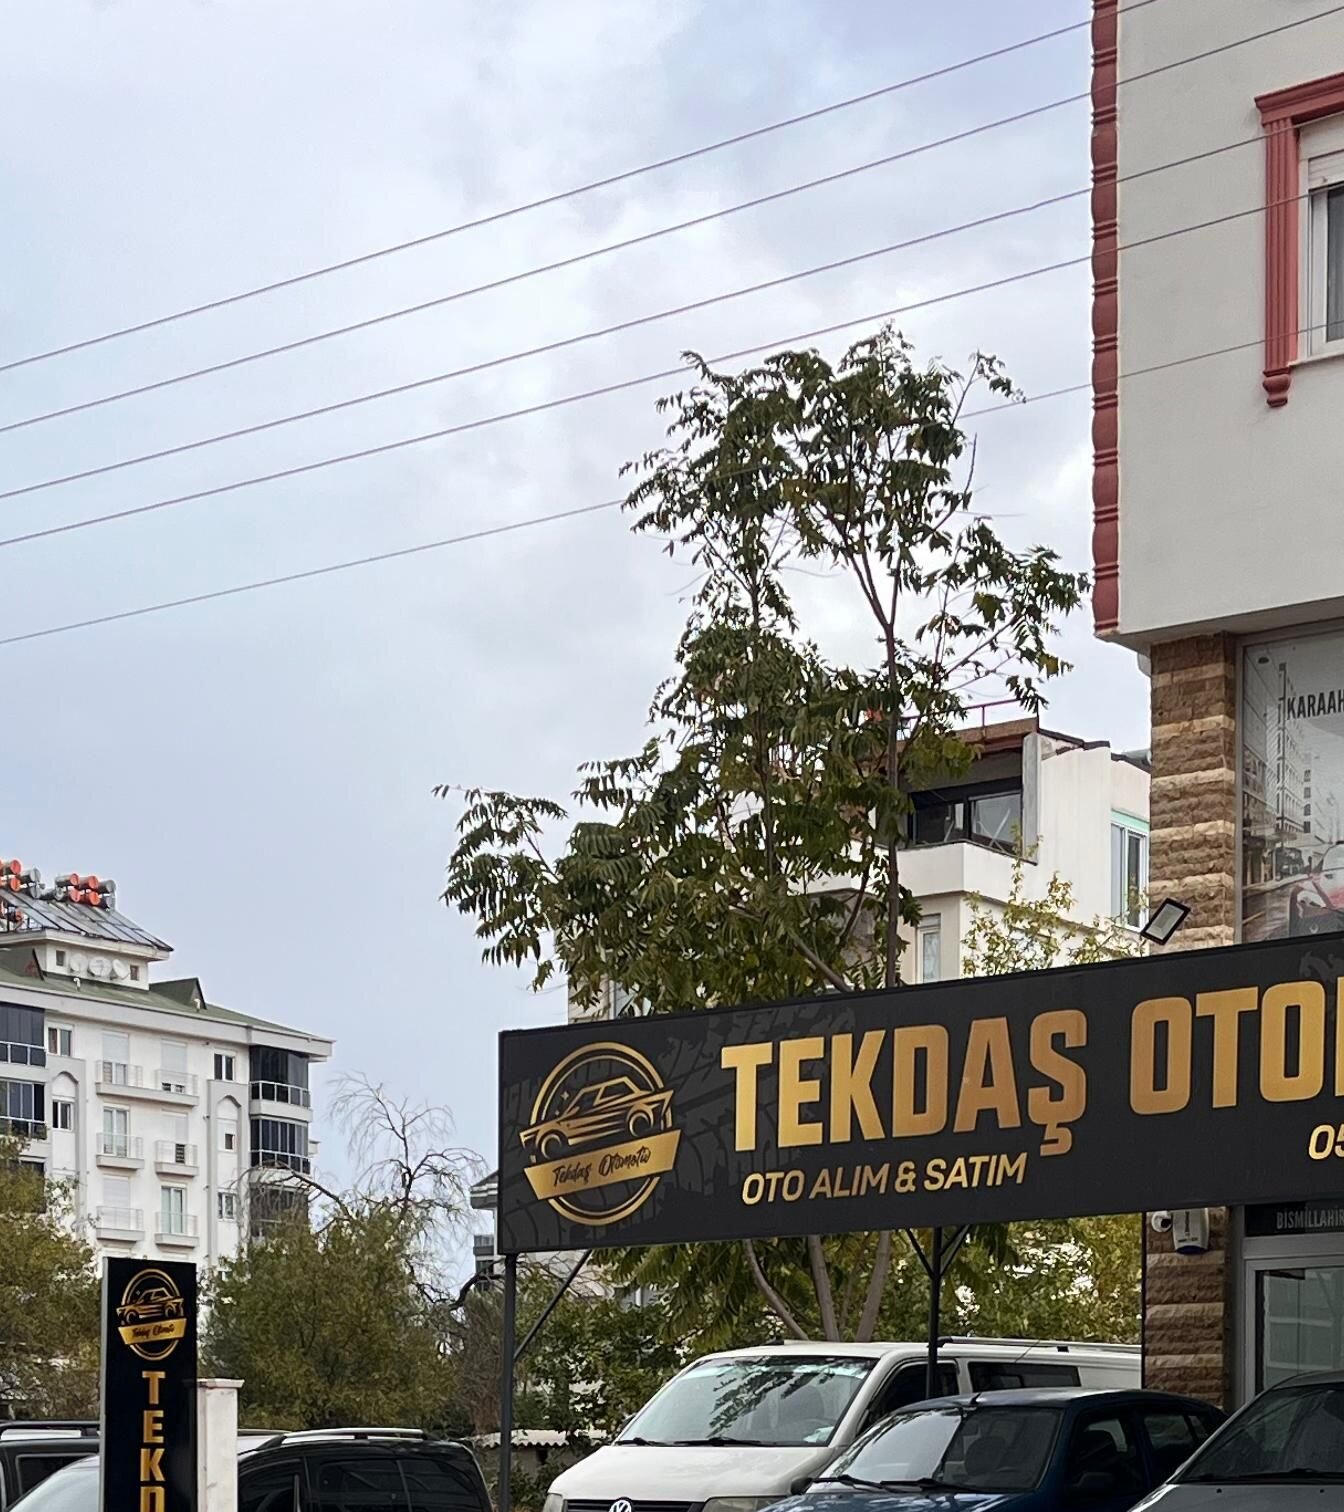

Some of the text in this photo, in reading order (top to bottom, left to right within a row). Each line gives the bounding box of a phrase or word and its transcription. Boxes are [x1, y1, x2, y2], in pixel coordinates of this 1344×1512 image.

[721, 1008, 1088, 1157] TEKDAŞ
[741, 1151, 1028, 1206] OTO ALIM & SATIM
